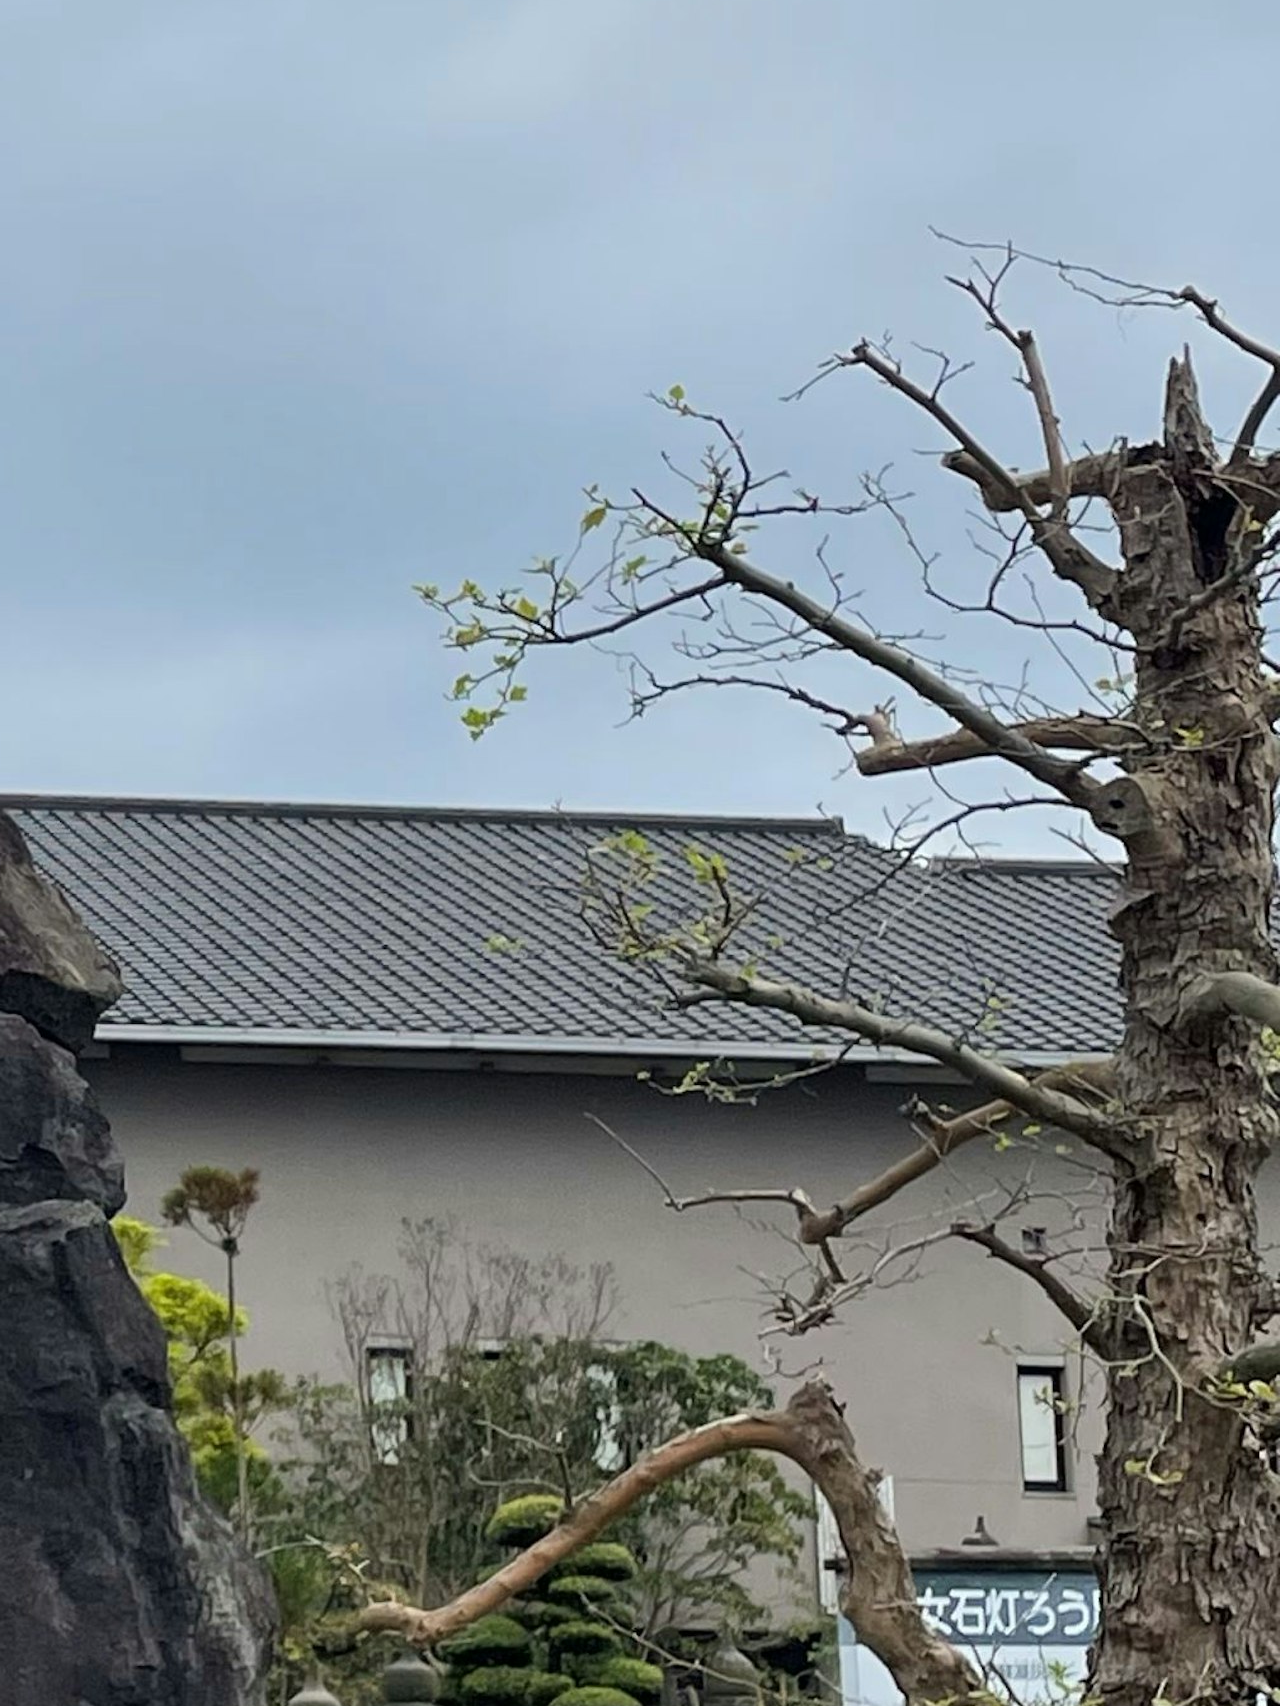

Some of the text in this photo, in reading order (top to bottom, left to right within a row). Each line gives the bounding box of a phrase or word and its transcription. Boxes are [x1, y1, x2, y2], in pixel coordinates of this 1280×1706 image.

[916, 1586, 1101, 1637] 女石灯ろう
